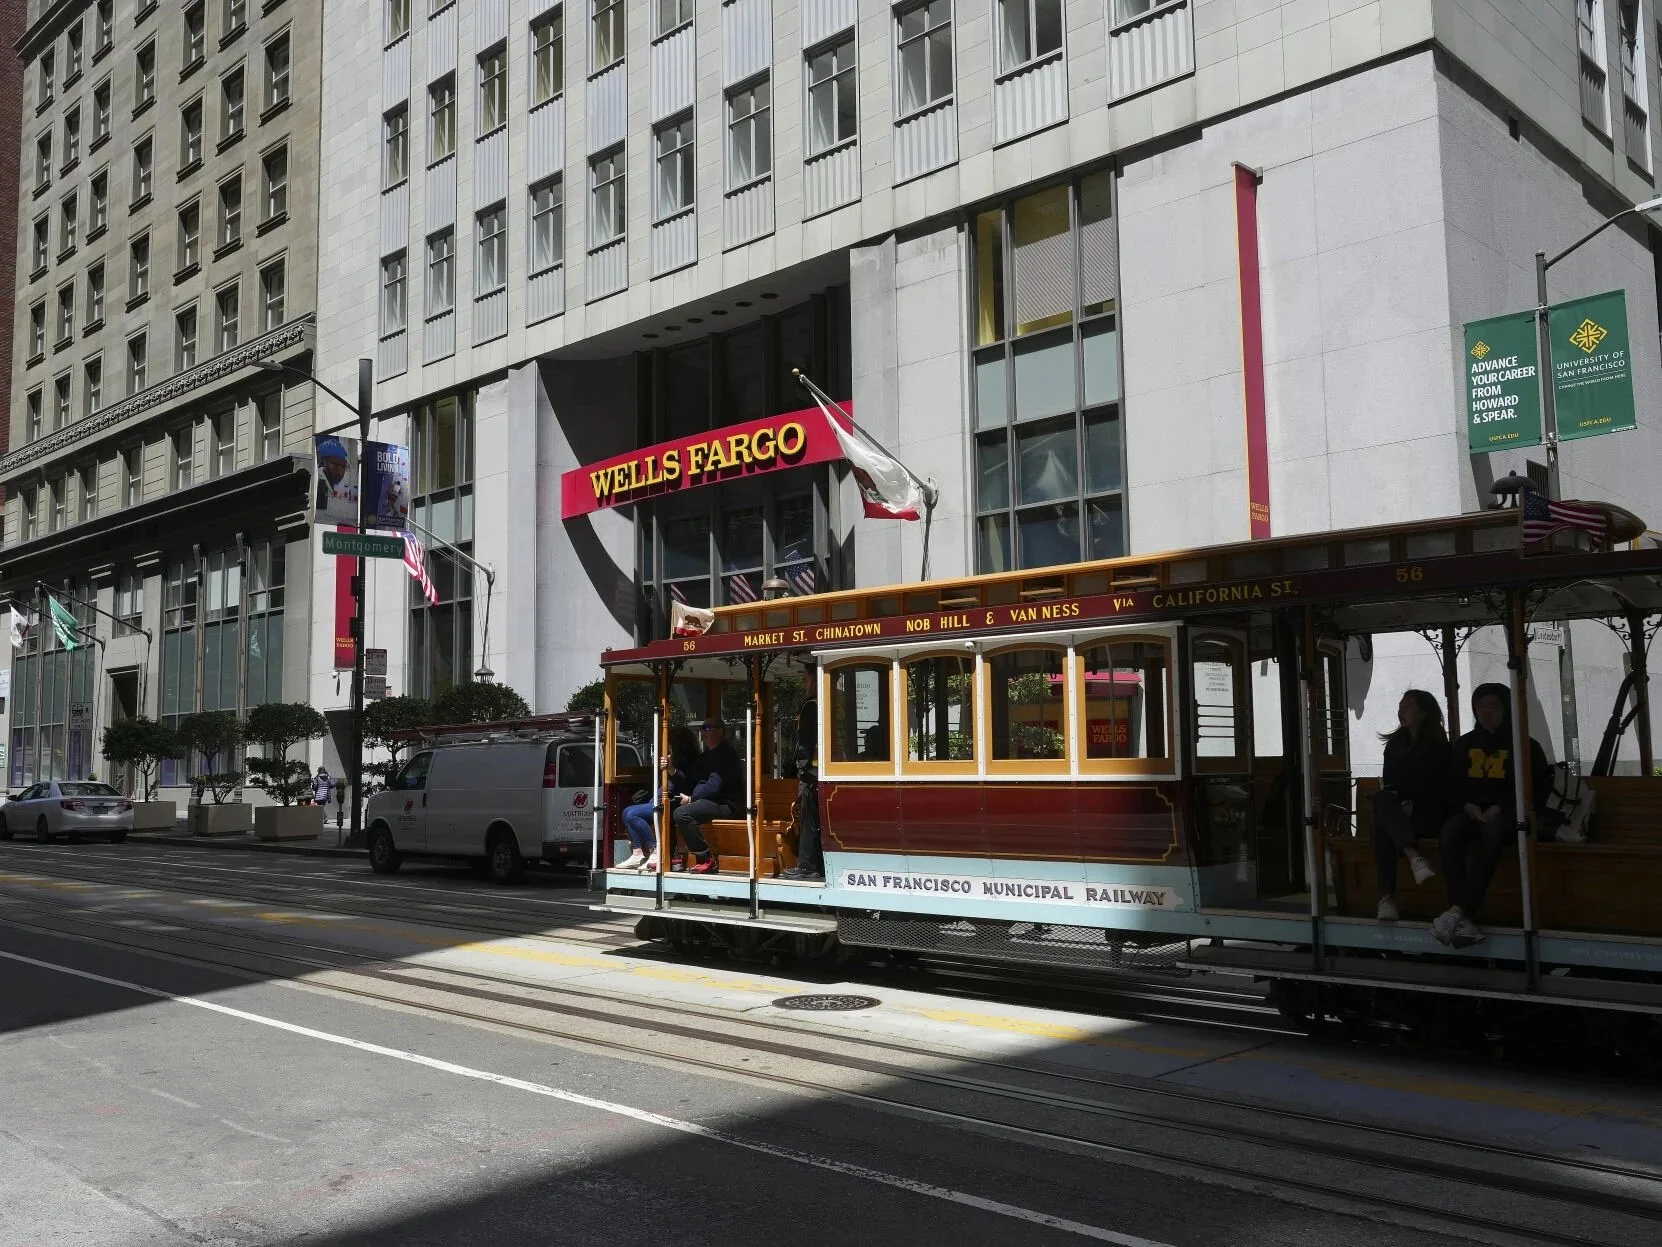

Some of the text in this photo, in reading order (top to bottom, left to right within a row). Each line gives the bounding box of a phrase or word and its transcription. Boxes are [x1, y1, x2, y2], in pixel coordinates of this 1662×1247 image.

[1471, 356, 1518, 374] ADVANCE
[1557, 350, 1624, 370] UNIVERSITY OF
[1557, 359, 1625, 379] SAN FRANCISCO
[1471, 366, 1536, 386] YOUR CAREER
[1472, 385, 1502, 399] FROM
[1472, 395, 1519, 412] HOWARD
[1473, 408, 1518, 424] & SPEAR.
[1579, 417, 1612, 427] USFCA.EDU
[590, 422, 804, 499] WELLS FARGO
[1251, 502, 1269, 512] WELLS
[1251, 512, 1269, 521] FARGO
[325, 539, 404, 555] Montgomery
[1396, 566, 1424, 584] 56
[683, 640, 696, 651] 56
[744, 632, 785, 647] MARKET
[792, 630, 808, 643] ST.
[815, 622, 882, 641] CHINATOWN
[906, 618, 931, 633] NOB
[940, 614, 970, 630] HILL
[985, 611, 995, 625] &
[1010, 607, 1037, 623] VAN
[1042, 603, 1080, 619] NESS
[1152, 583, 1264, 609] CALIFORNIA
[1468, 748, 1508, 778] M
[847, 873, 1167, 906] SAN FRANCISCO MUNICIPAL RAILWAY
